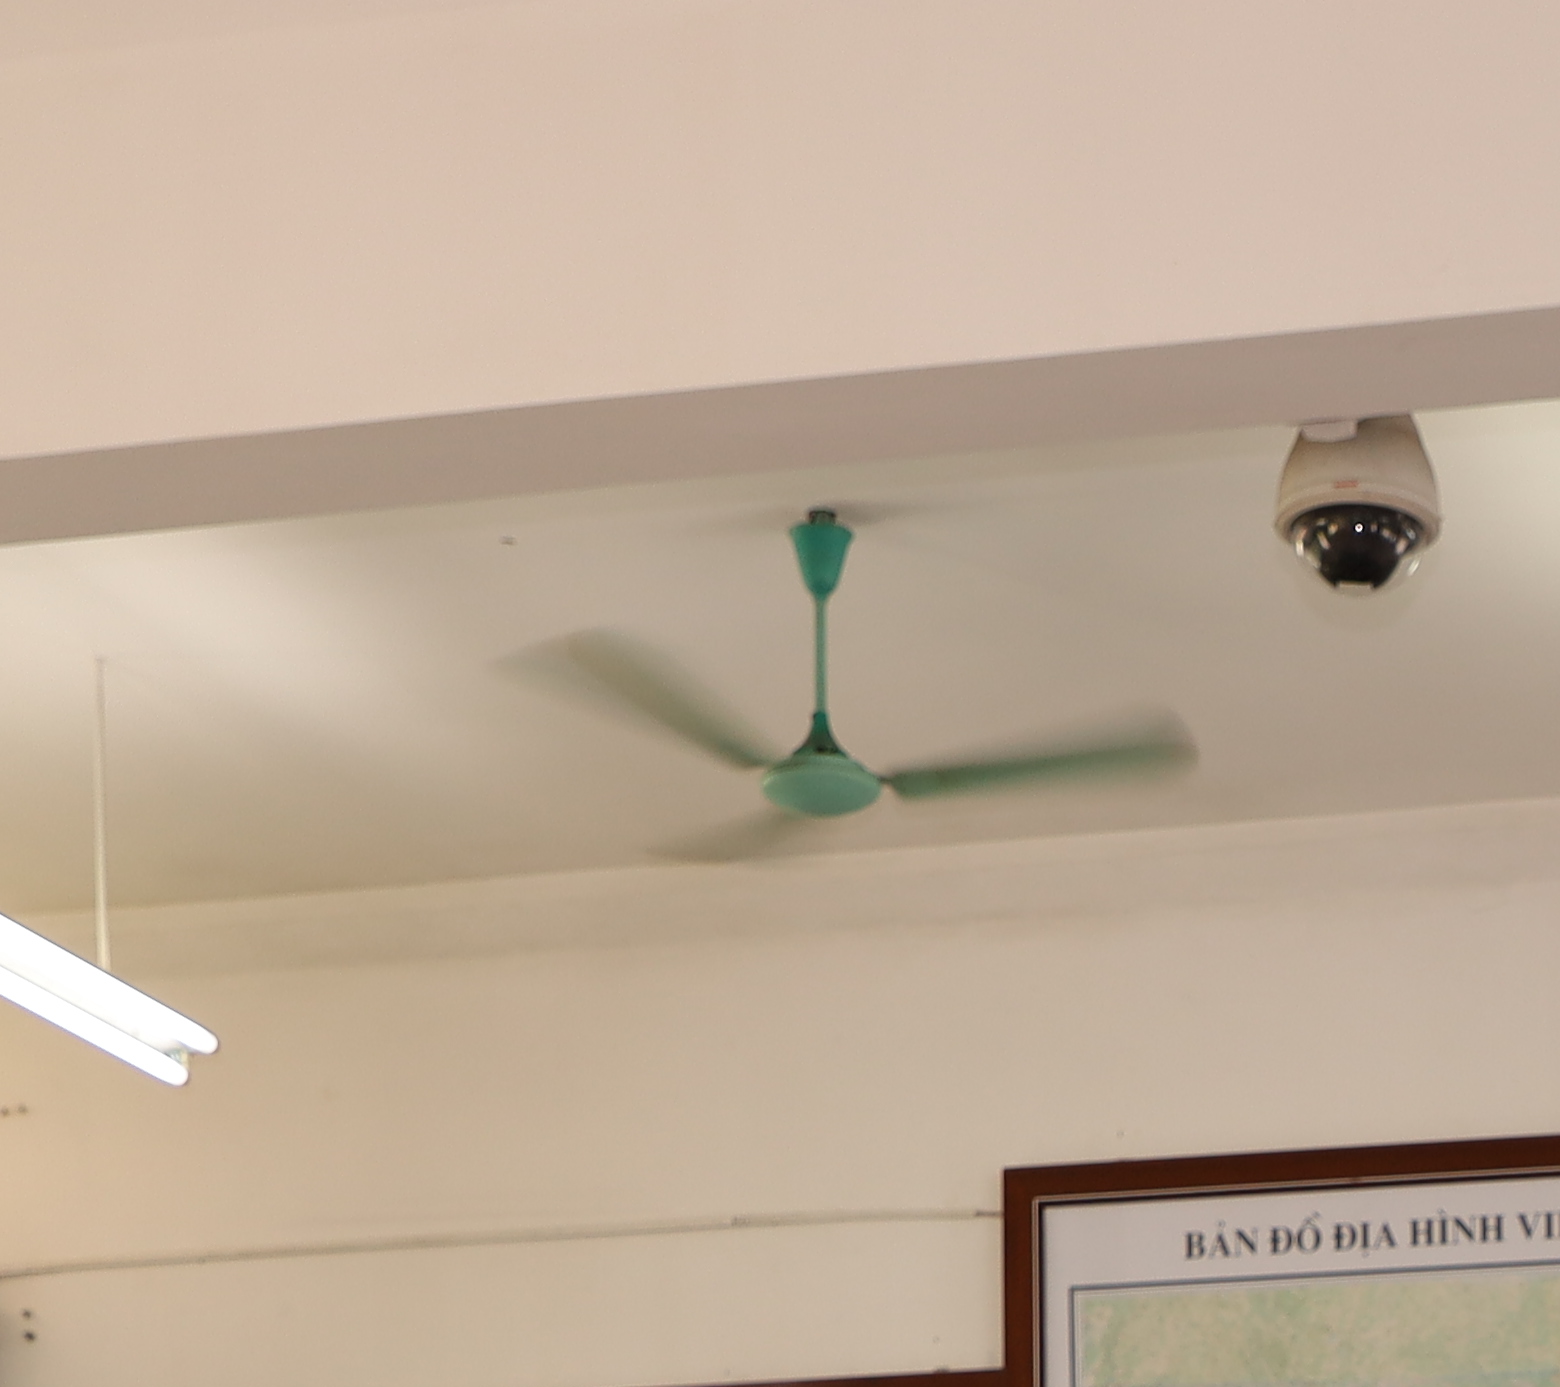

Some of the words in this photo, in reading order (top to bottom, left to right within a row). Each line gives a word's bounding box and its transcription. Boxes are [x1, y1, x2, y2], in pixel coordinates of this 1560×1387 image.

[1184, 1219, 1258, 1261] BẢN
[1270, 1211, 1322, 1255] ĐỒ
[1334, 1221, 1397, 1257] ĐỊA
[1409, 1209, 1506, 1247] HÌNH
